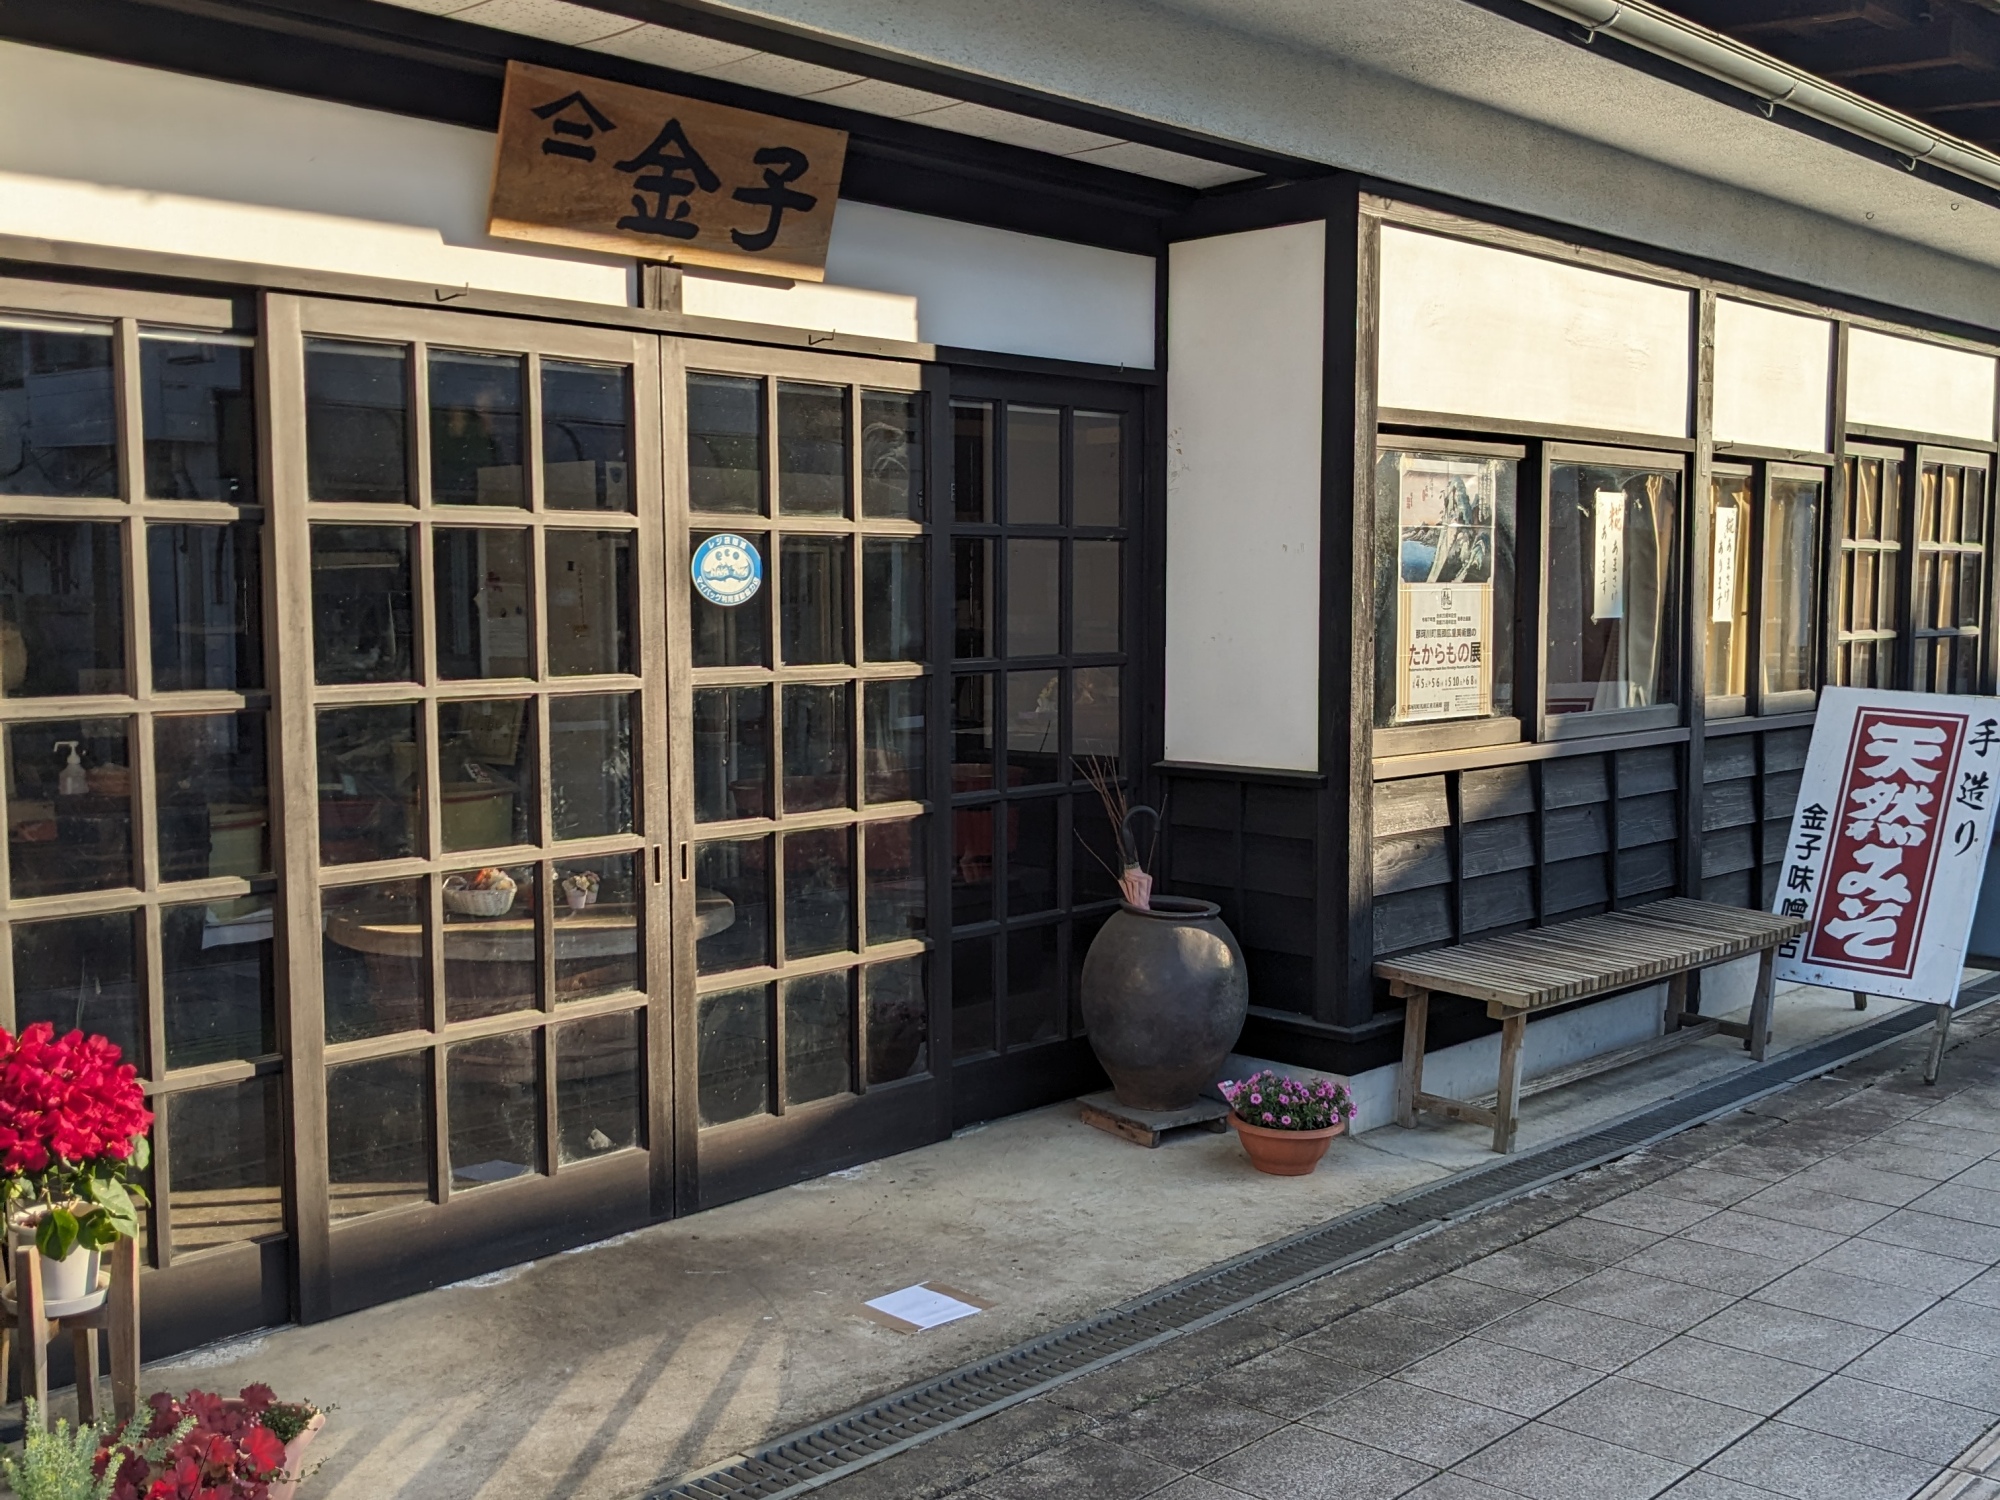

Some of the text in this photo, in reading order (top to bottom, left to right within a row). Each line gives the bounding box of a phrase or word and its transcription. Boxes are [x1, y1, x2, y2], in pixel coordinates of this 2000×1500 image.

[614, 118, 818, 252] 金子
[715, 549, 740, 561] eco
[1600, 524, 1608, 595] あります
[1409, 641, 1481, 666] たからもの展
[1953, 717, 2000, 857] 手造り
[1823, 721, 1948, 961] 天然みそ
